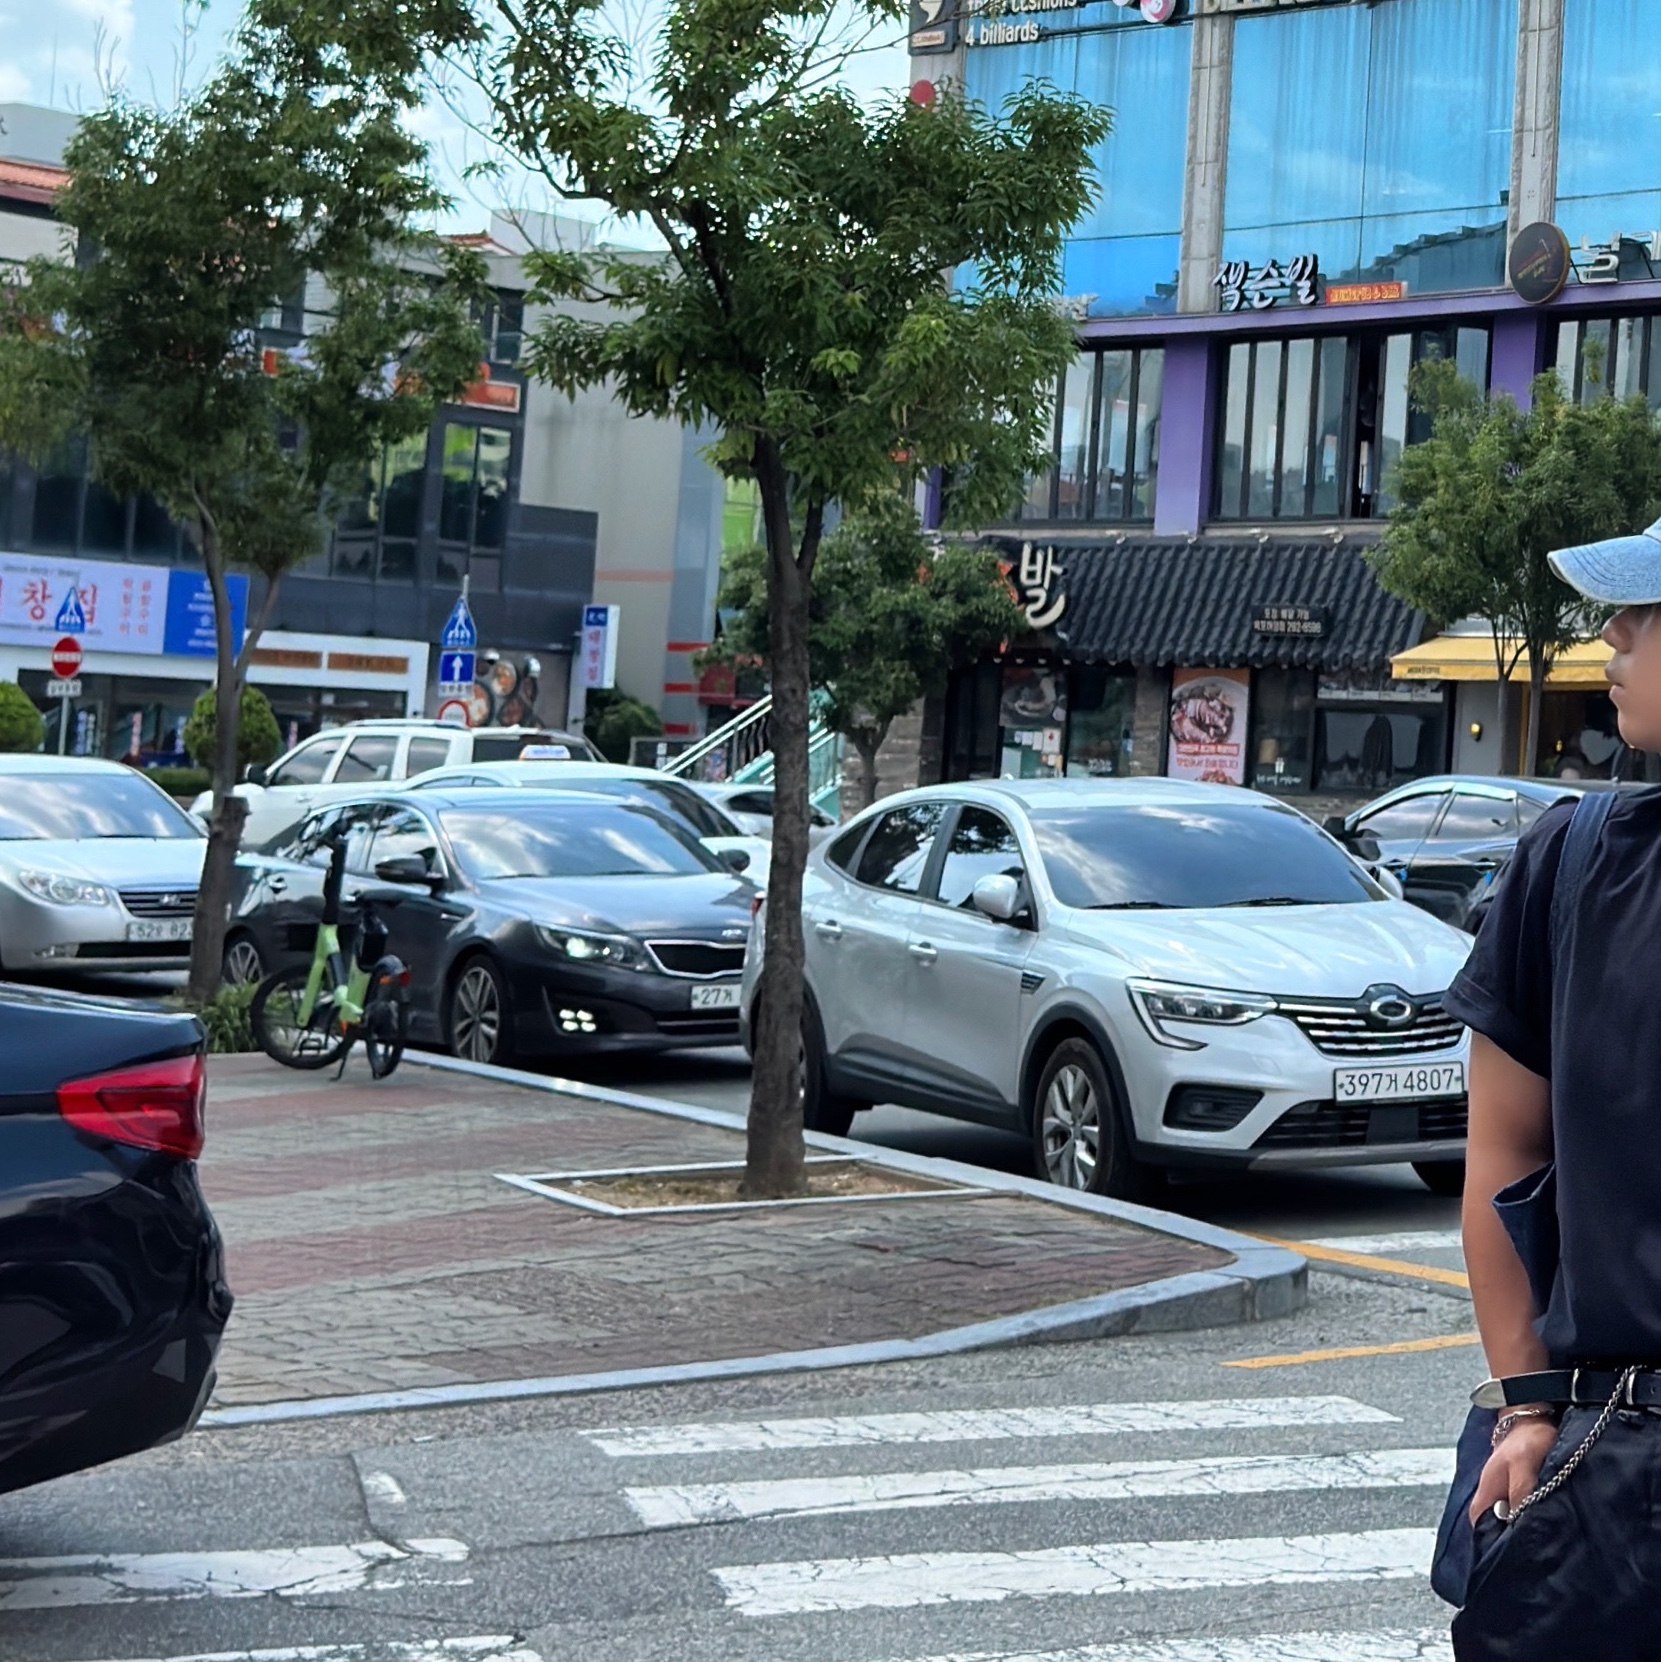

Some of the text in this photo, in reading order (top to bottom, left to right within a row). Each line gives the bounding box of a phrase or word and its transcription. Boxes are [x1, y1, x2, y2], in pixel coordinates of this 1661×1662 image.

[965, 25, 974, 45] 4
[980, 20, 1038, 44] billiards
[1213, 254, 1317, 312] 잭슨빌
[1344, 1068, 1454, 1096] 397거 4807
